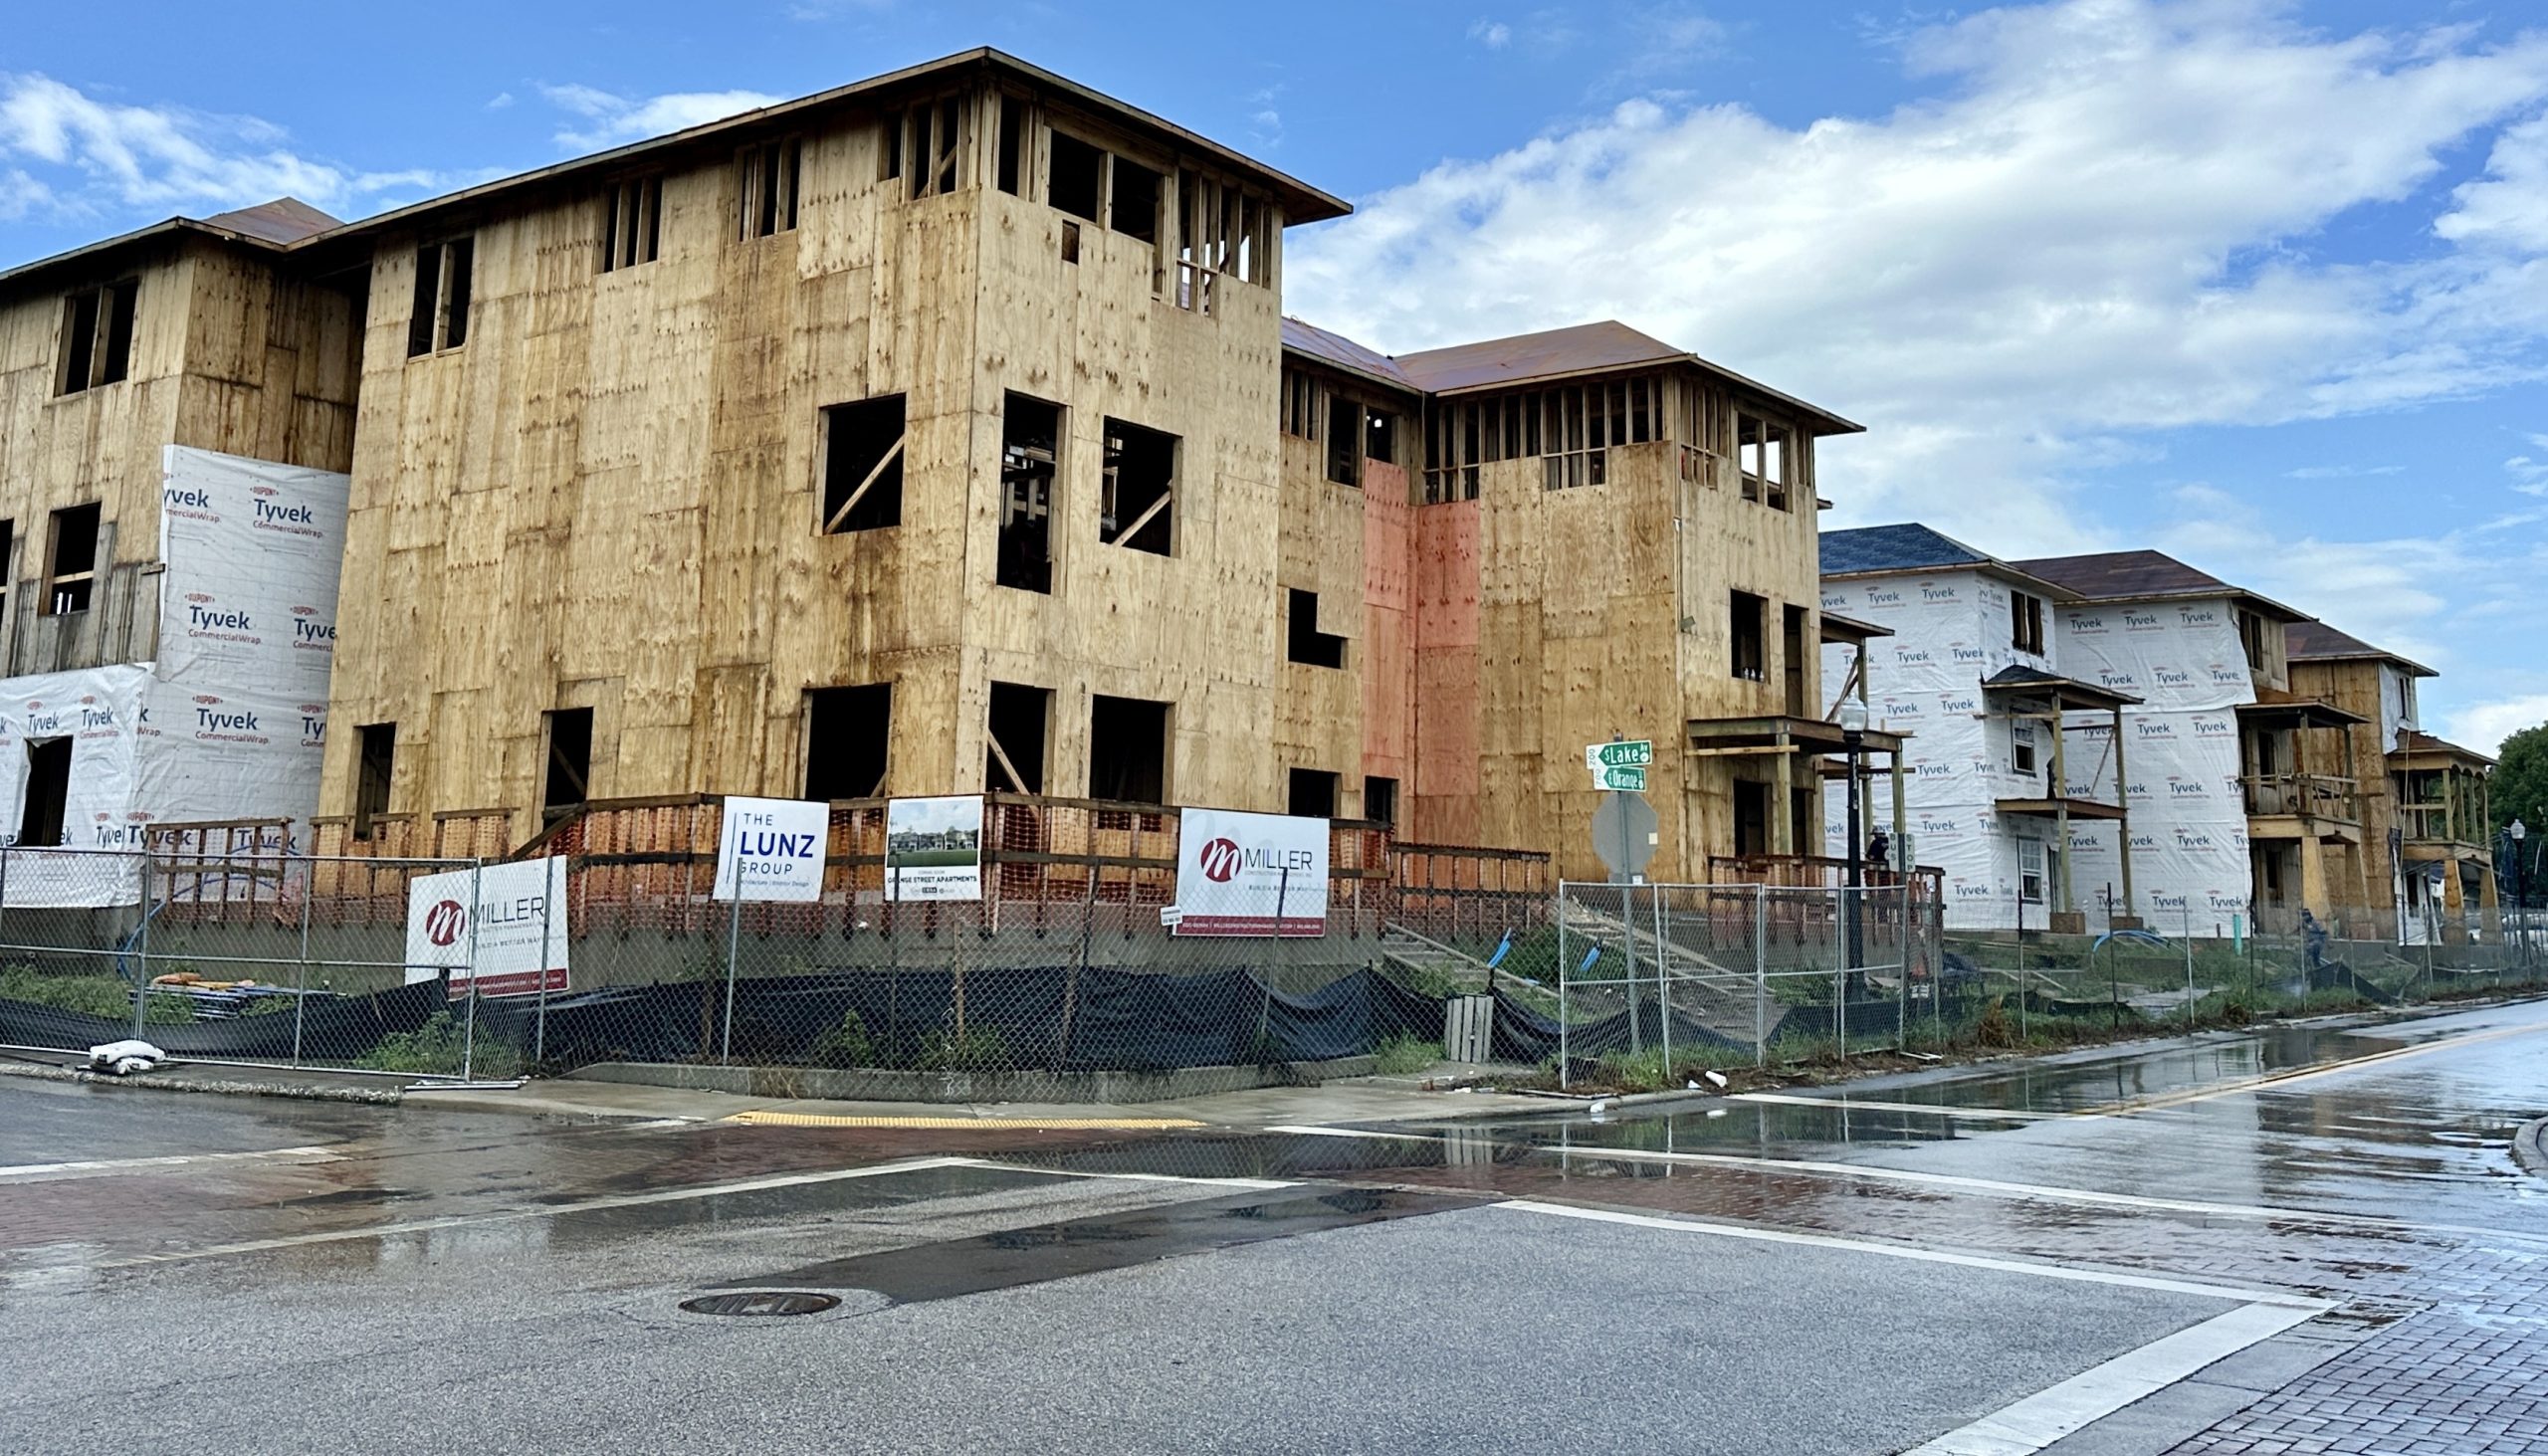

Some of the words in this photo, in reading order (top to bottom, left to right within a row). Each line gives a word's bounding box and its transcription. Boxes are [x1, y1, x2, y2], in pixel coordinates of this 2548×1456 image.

[253, 498, 313, 523] Tyvek
[252, 520, 324, 538] CommercialWrap
[1867, 591, 1900, 604] Tyvek
[1921, 587, 1956, 601] Tyvek
[189, 604, 251, 631] Tyvek
[2069, 617, 2102, 631] Tyvek
[2124, 614, 2158, 627] Tyvek
[2180, 611, 2214, 624] Tyvek
[187, 629, 262, 645] CommercialWrap
[1897, 650, 1930, 664] Tyvek
[1952, 647, 1984, 661] Tyvek
[2100, 674, 2134, 687] Tyvek
[2155, 671, 2189, 685] Tyvek
[1885, 703, 1919, 716] Tyvek
[1941, 699, 1975, 713] Tyvek
[27, 712, 60, 737] Tyvek
[82, 707, 114, 730] Tyvek
[196, 707, 259, 731] Tyvek
[2137, 724, 2170, 735] Tyvek
[2193, 721, 2228, 733] Tyvek
[195, 730, 270, 745] CommercialWrap
[1604, 749, 1609, 761] S
[1609, 745, 1638, 763] Lake
[1917, 763, 1951, 776] Tyvek
[1612, 769, 1637, 789] Orange
[2170, 781, 2203, 794] Tyvek
[743, 813, 773, 826] THE
[1922, 820, 1957, 833] Tyvek
[740, 831, 815, 858] LUNZ
[2177, 834, 2210, 847] Tyvek
[1245, 848, 1313, 871] MILLER
[1954, 884, 1989, 897] Tyvek
[2152, 896, 2187, 908] Tyvek
[2210, 896, 2243, 908] Tyvek
[469, 896, 545, 926] MILLER
